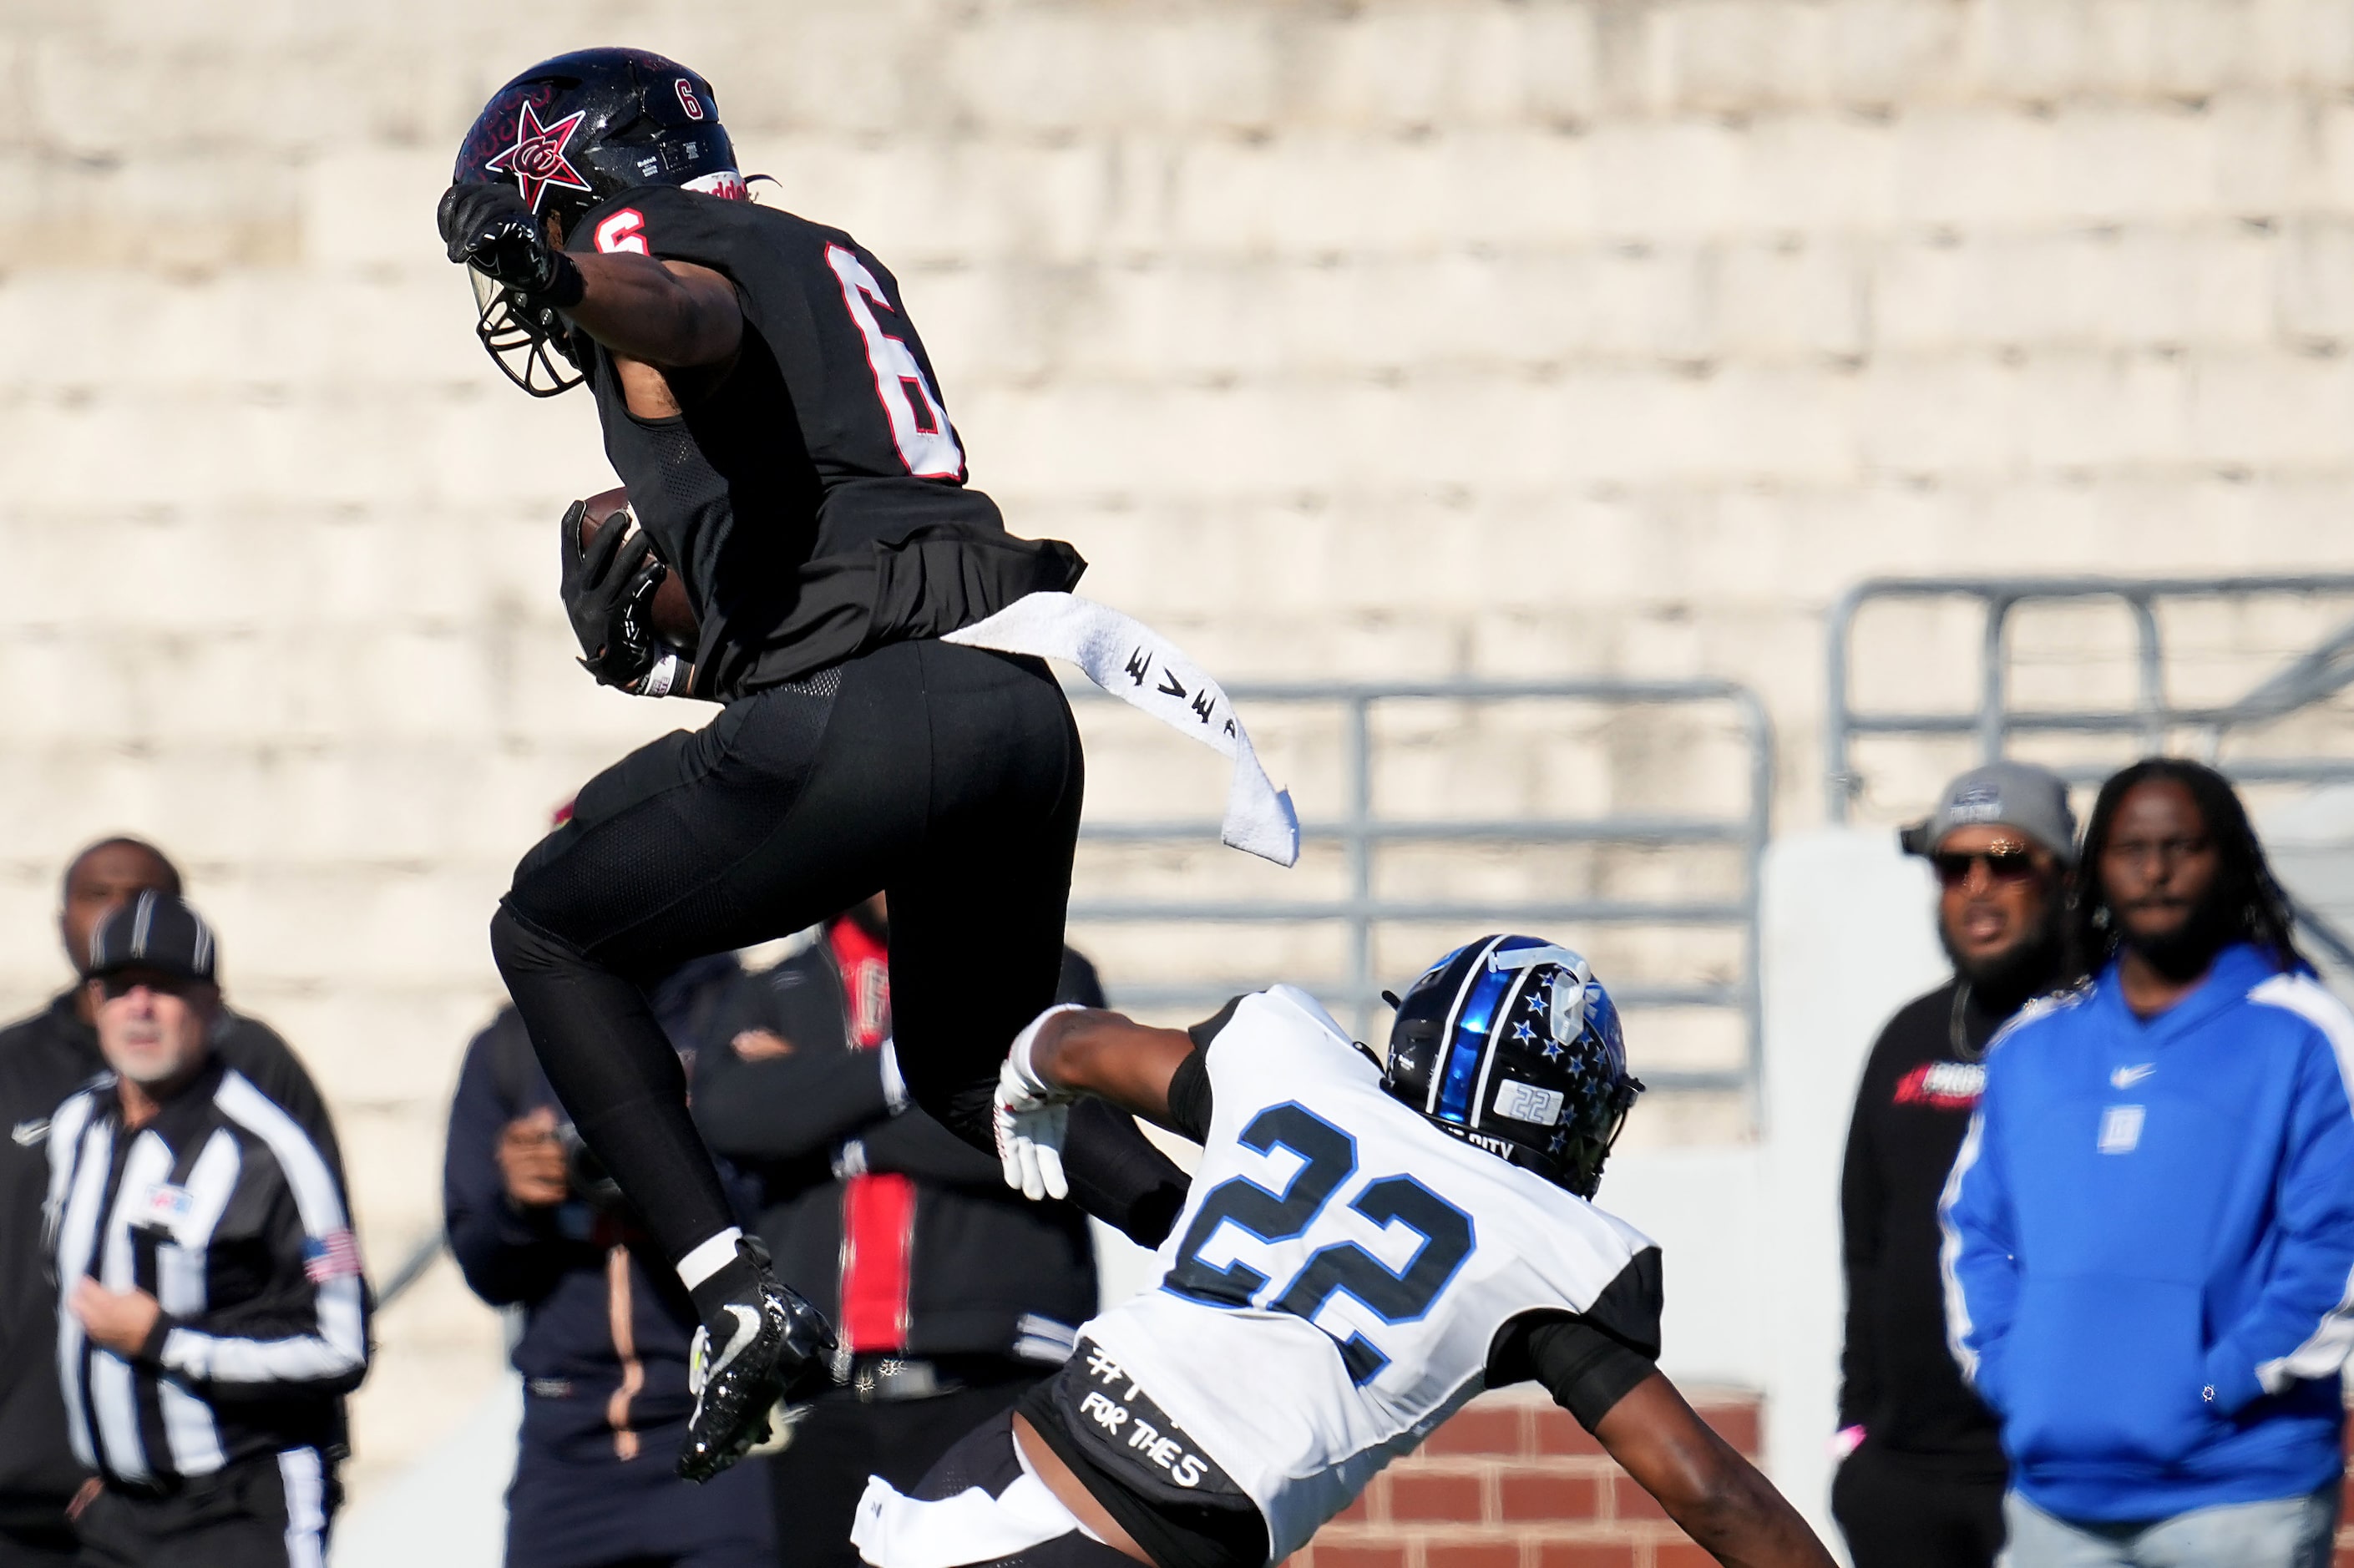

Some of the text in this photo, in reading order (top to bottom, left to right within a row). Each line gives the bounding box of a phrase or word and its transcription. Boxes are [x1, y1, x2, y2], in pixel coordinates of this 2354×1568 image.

[674, 78, 704, 120] 6
[823, 240, 965, 481] 6
[1510, 1085, 1551, 1123] 22
[1158, 1099, 1477, 1387] 22
[1080, 1391, 1129, 1436] FOR
